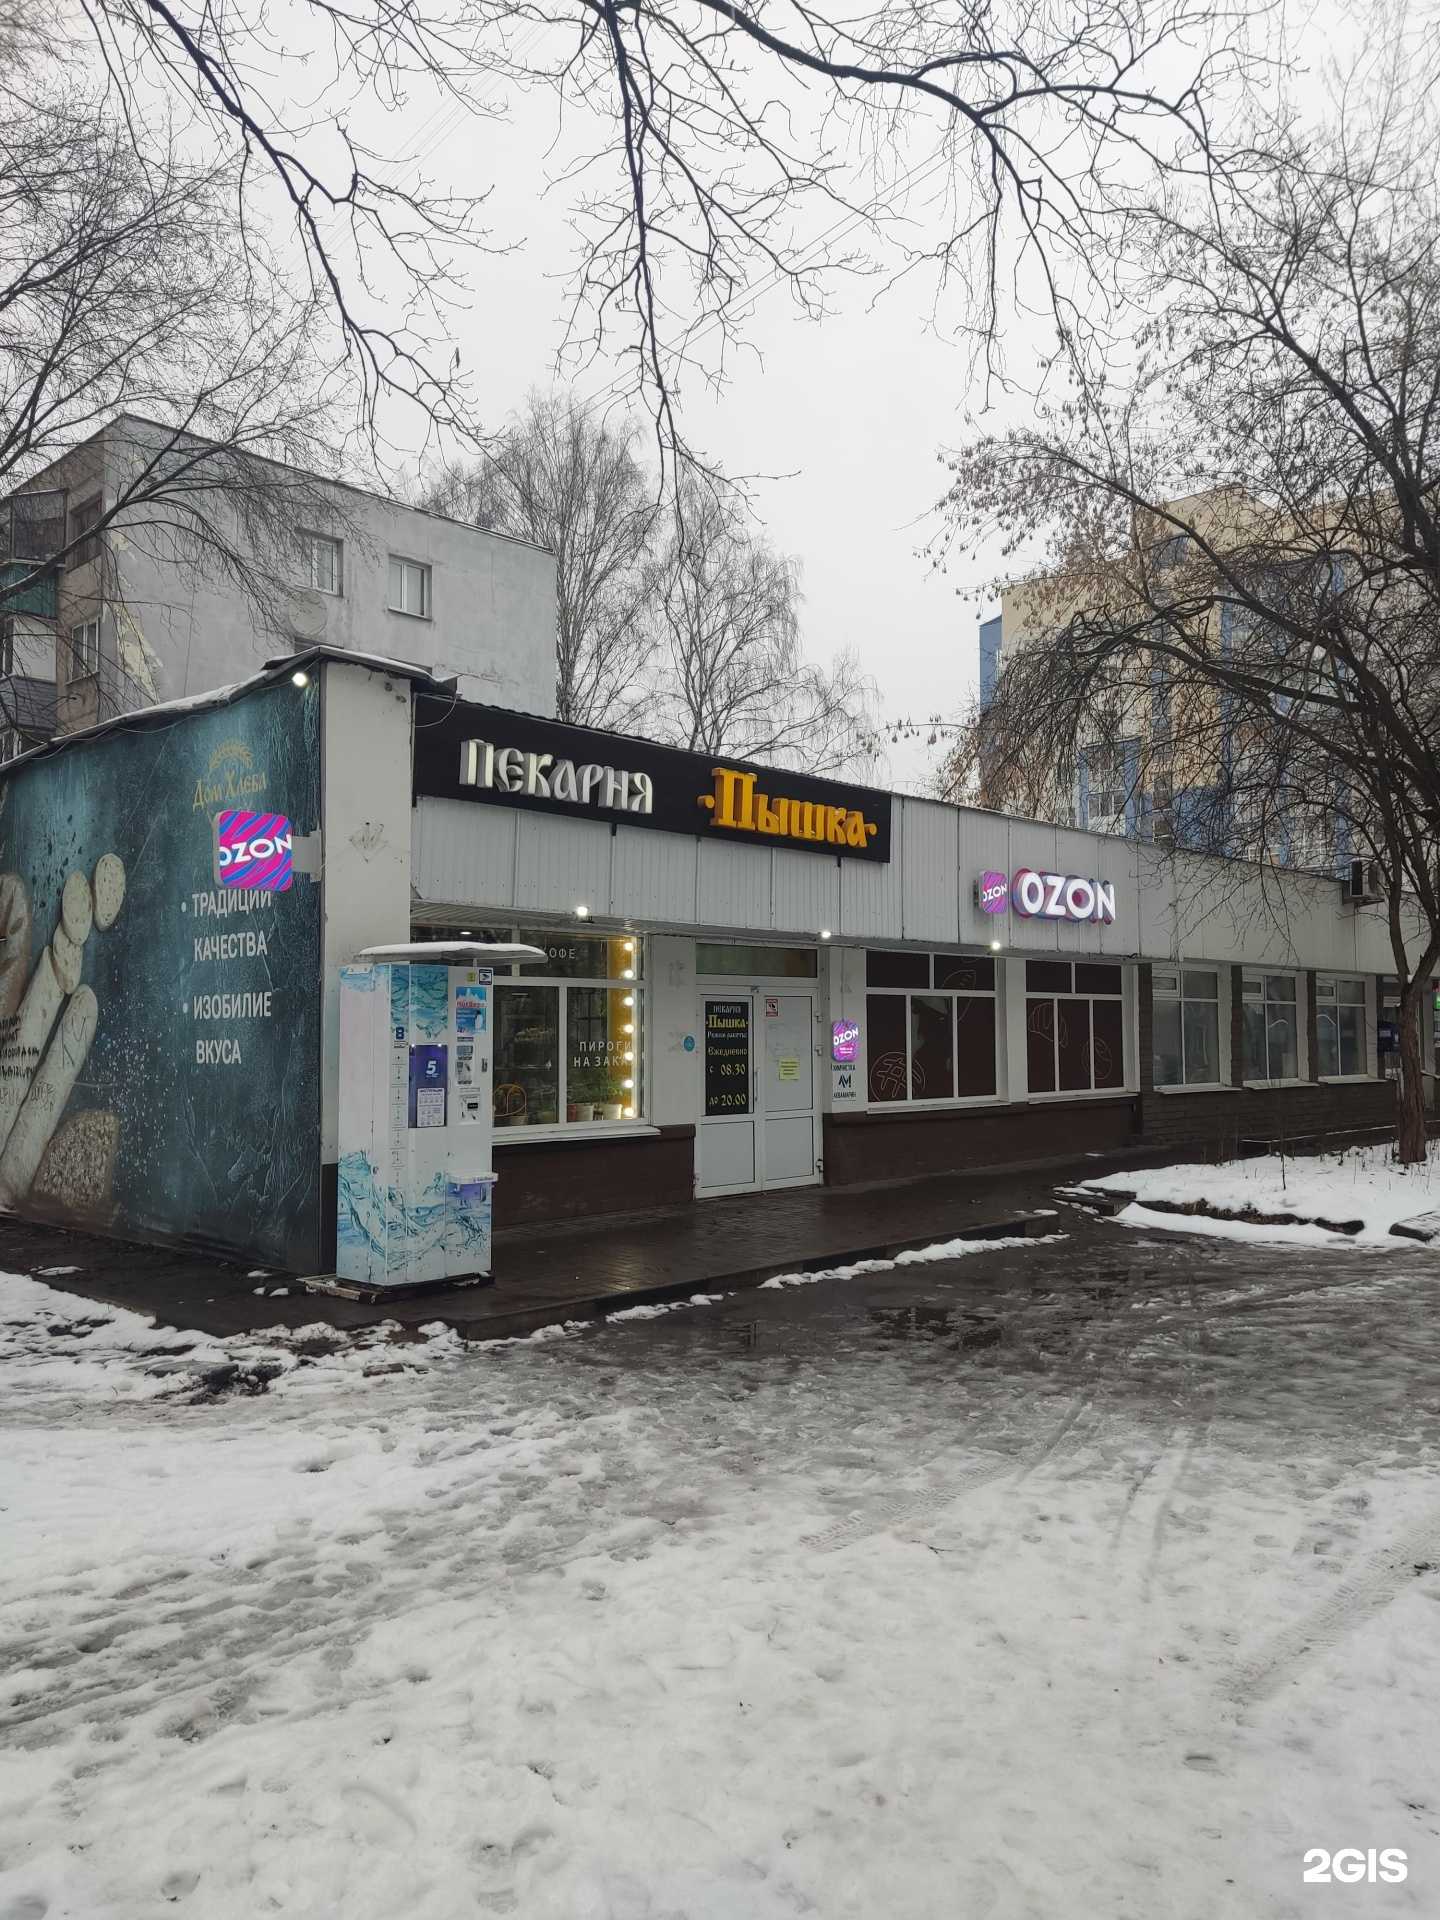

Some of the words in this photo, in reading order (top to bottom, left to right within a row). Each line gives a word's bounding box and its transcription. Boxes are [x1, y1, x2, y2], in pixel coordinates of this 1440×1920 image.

[218, 833, 292, 867] OZON
[192, 888, 272, 918] ТРАДИЦИИ
[982, 882, 1008, 902] OZON
[1017, 870, 1117, 921] OZON
[194, 930, 268, 962] КАЧЕСТВА
[544, 947, 577, 960] ОФЕ
[193, 991, 272, 1020] ИЗОБИЛИЕ
[579, 1040, 632, 1052] ПИРОГИ
[833, 1027, 859, 1046] OZON
[195, 1039, 242, 1065] ВКУСА
[573, 1056, 590, 1067] НА
